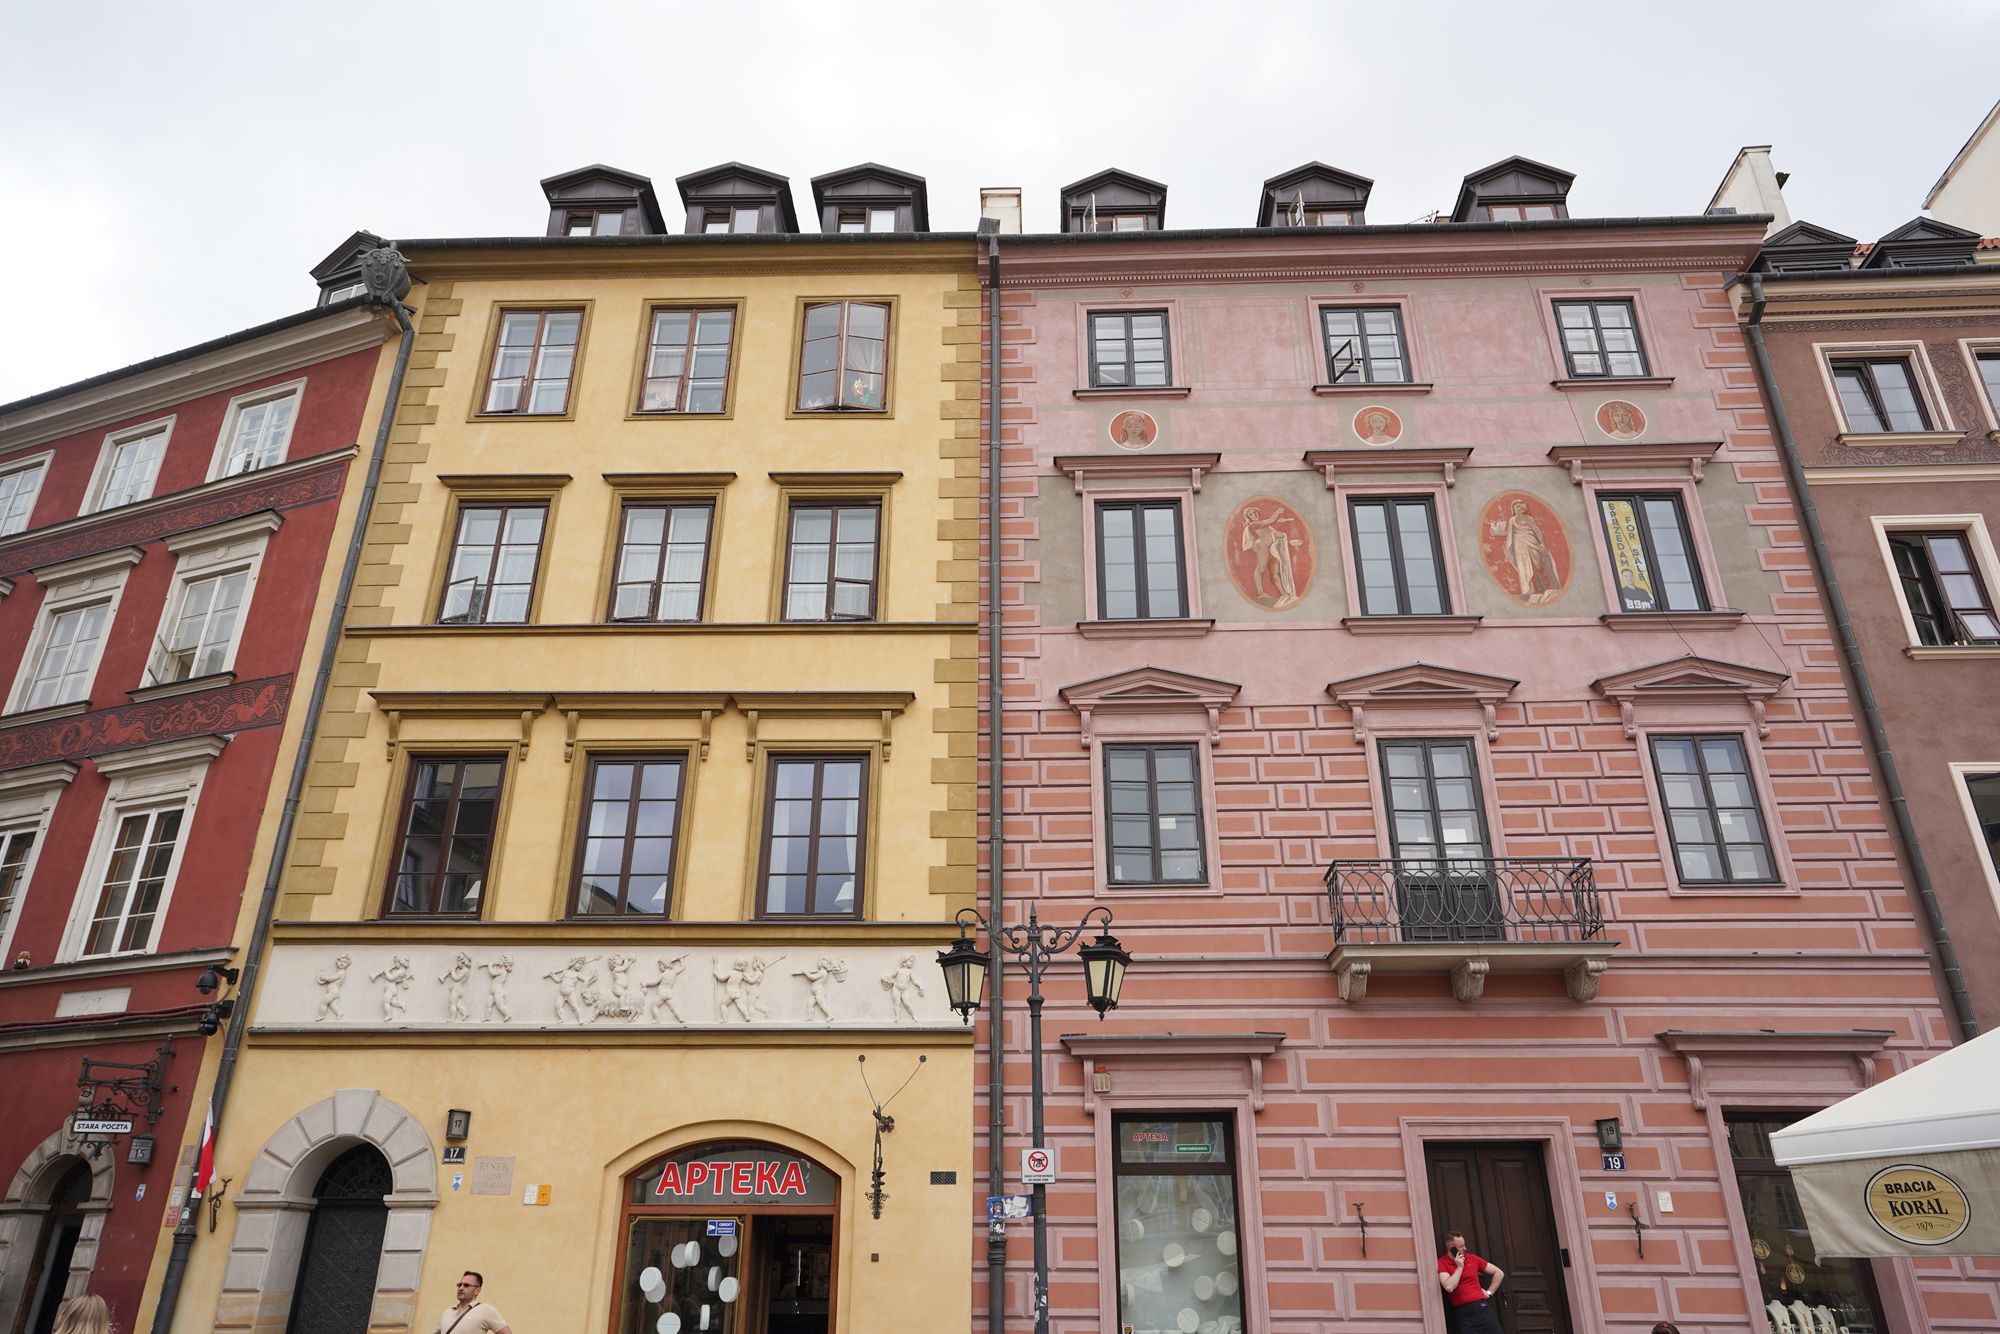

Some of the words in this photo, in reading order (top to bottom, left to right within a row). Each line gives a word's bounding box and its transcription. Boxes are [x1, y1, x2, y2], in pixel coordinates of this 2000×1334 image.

[1608, 502, 1629, 567] SPRZEDAM
[1625, 516, 1636, 540] FOR
[1632, 548, 1645, 581] SALE
[454, 1119, 462, 1128] 17
[1132, 1132, 1168, 1142] APTEKA
[1606, 1126, 1615, 1136] 19
[135, 1149, 146, 1158] 15
[449, 1147, 460, 1158] 17
[1608, 1156, 1621, 1169] 19
[655, 1161, 807, 1196] APTEKA
[1884, 1180, 1937, 1194] BRACIA
[1888, 1198, 1949, 1217] KORAL
[1916, 1221, 1934, 1231] 1979
